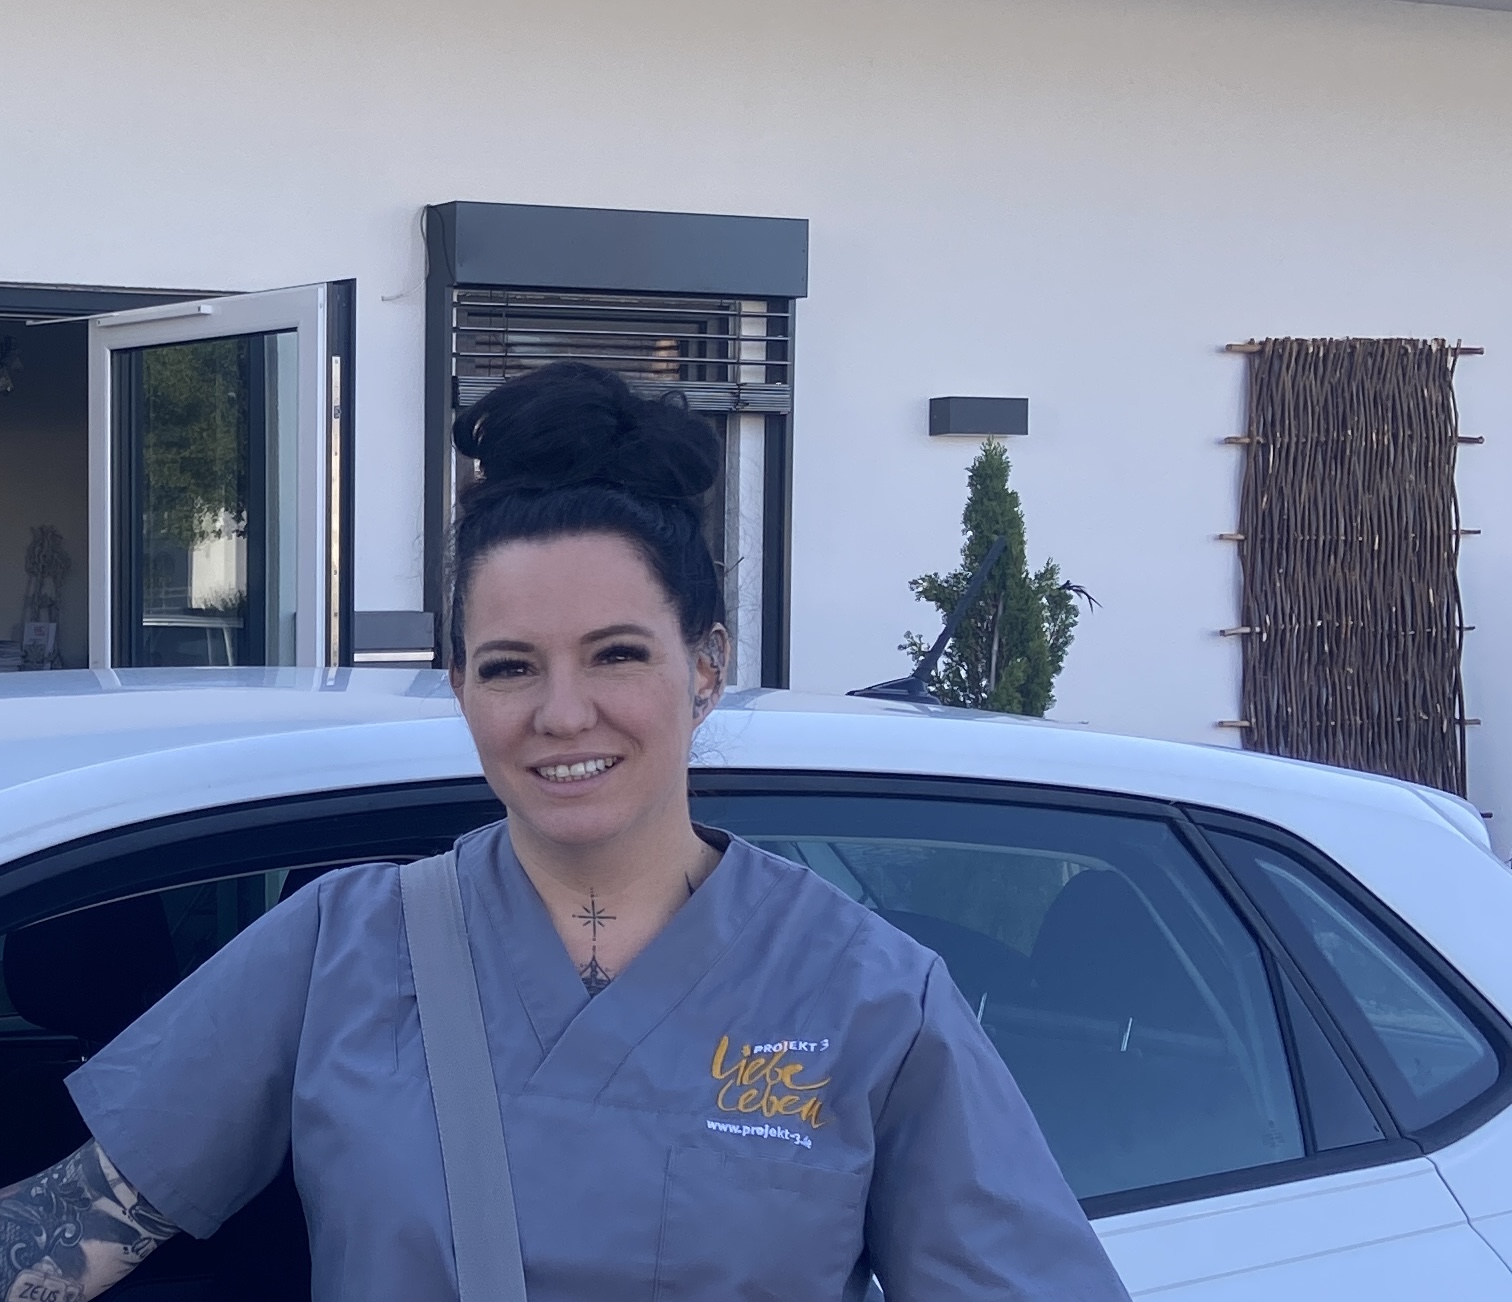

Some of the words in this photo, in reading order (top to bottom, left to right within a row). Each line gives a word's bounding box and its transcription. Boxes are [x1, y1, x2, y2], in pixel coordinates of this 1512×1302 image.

[711, 1035, 832, 1091] Liebe
[753, 1040, 817, 1054] PROJEKT
[819, 1038, 830, 1052] 3
[717, 1078, 836, 1129] Leben
[706, 1119, 812, 1149] www.projekt-3.de
